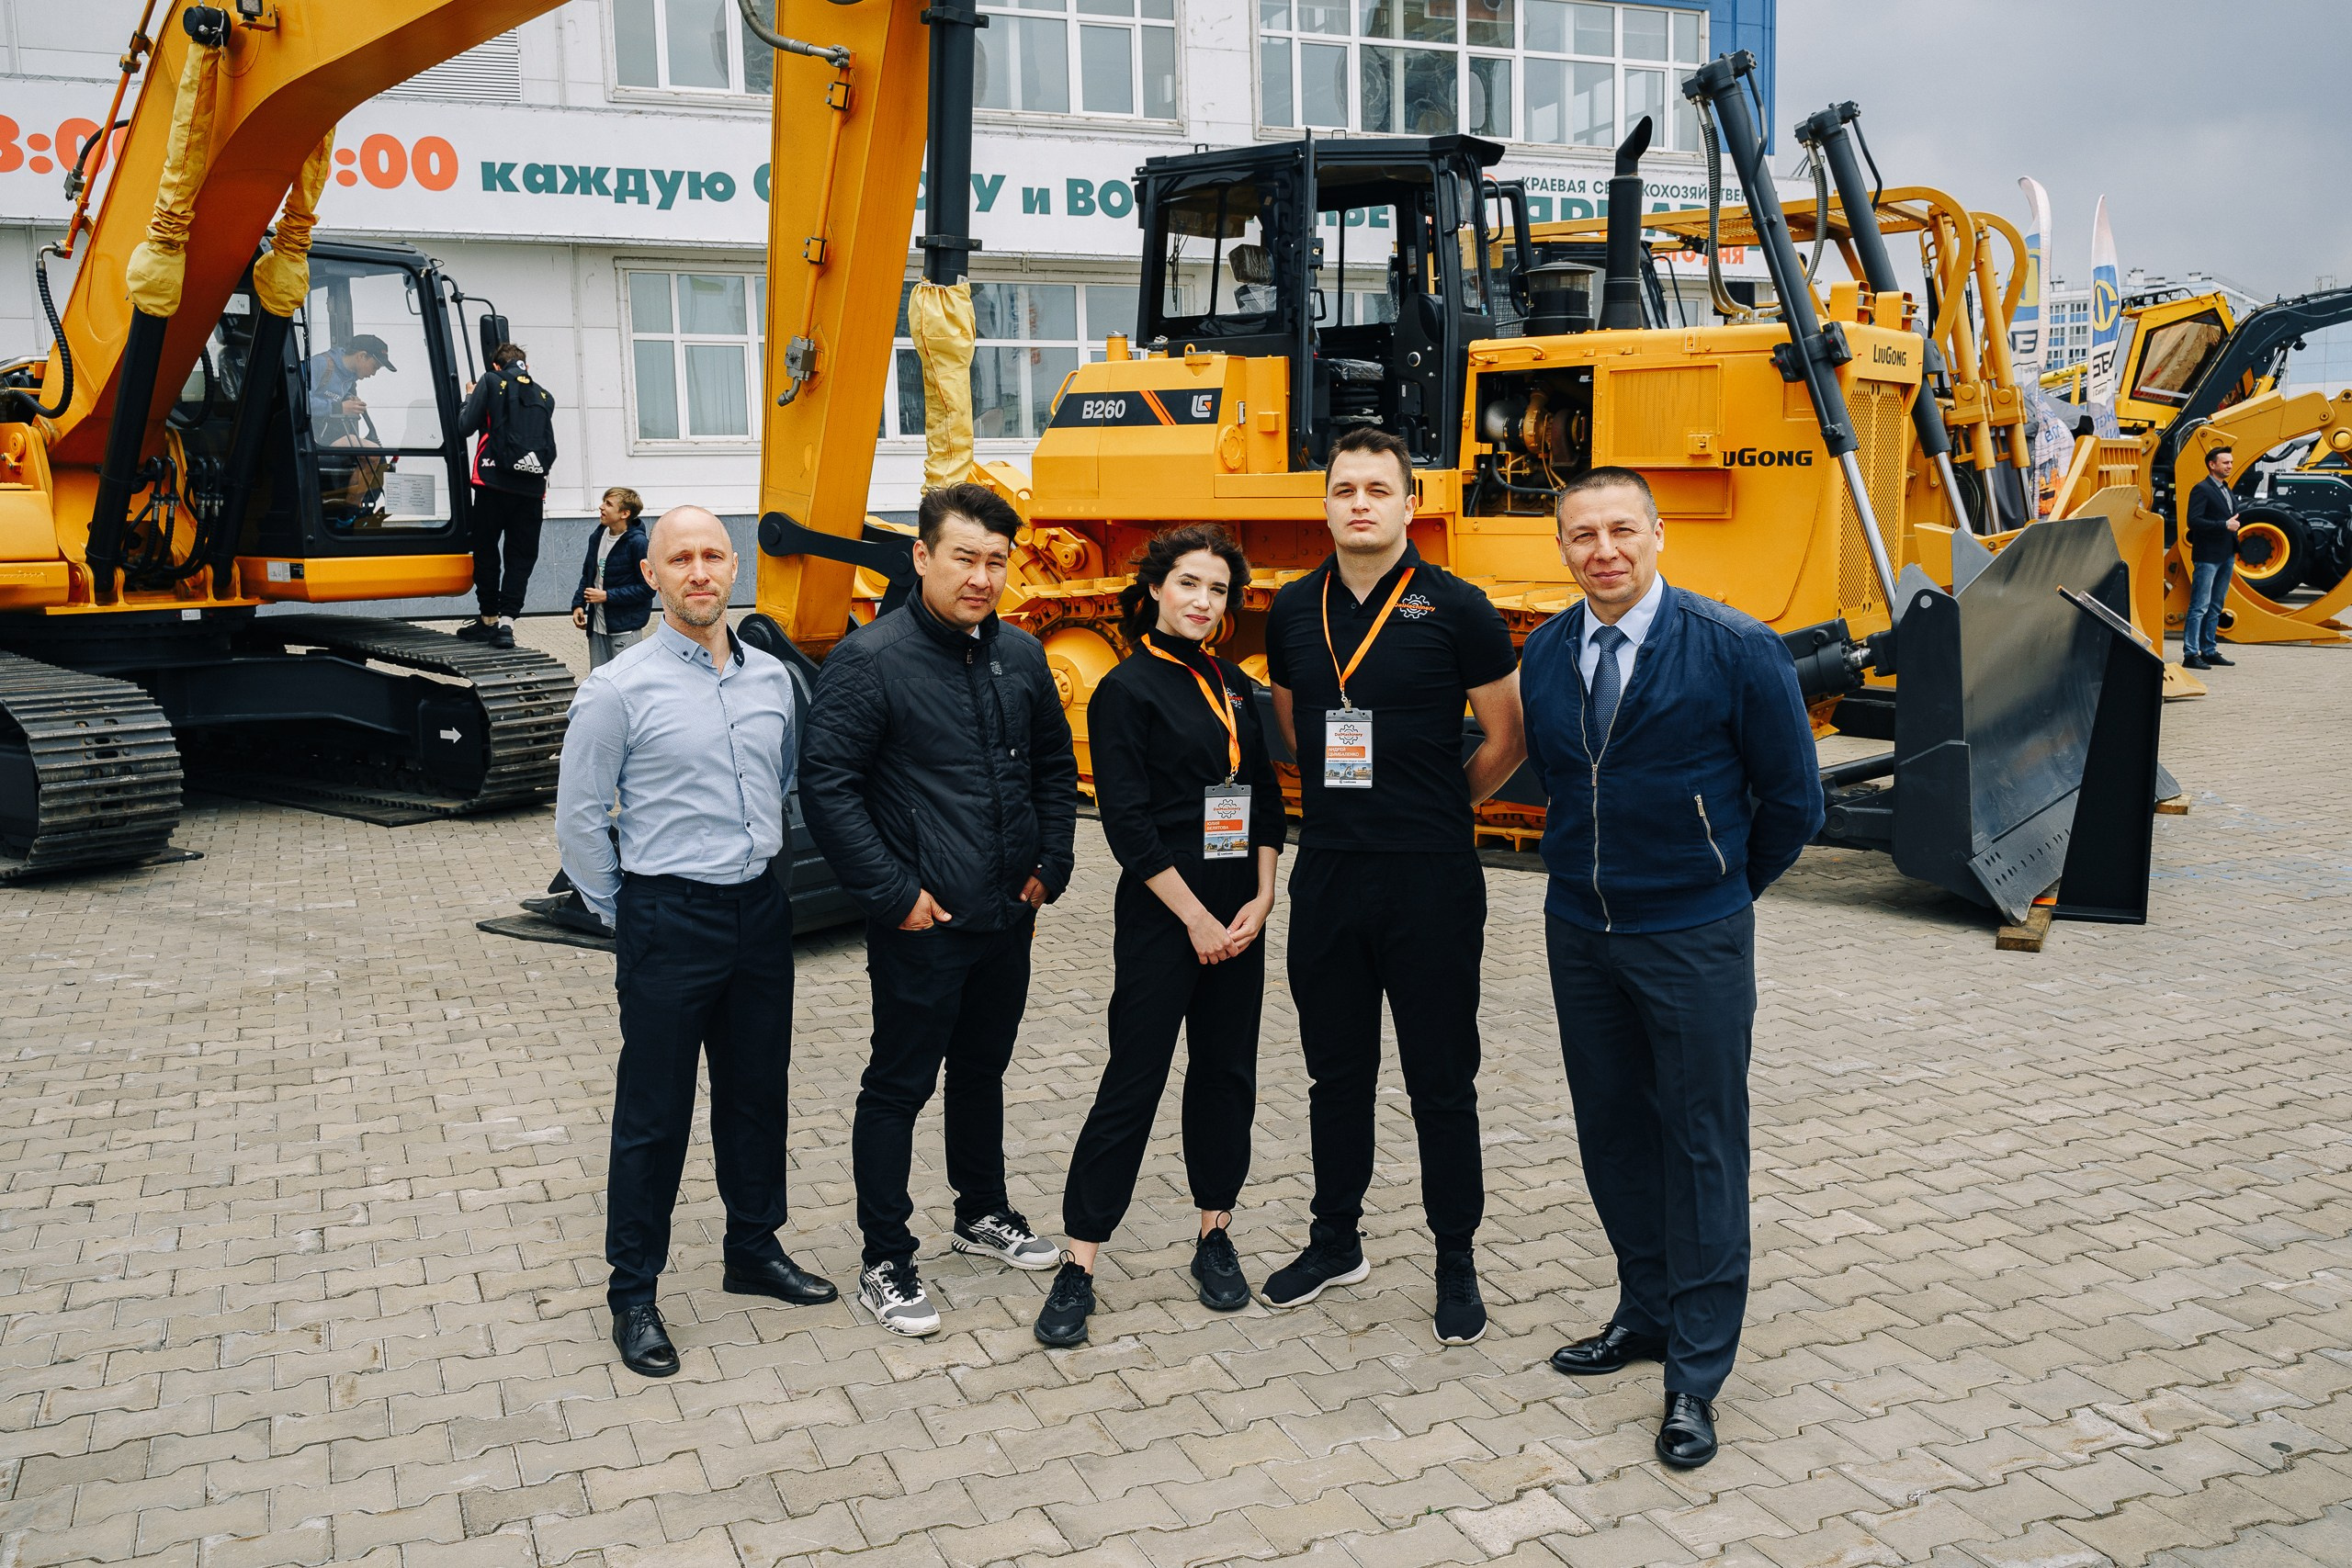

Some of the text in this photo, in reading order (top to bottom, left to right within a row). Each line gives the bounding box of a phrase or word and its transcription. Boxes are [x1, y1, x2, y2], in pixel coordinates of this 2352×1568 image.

[481, 161, 736, 210] каждую
[1022, 187, 1050, 215] и
[1521, 176, 1587, 193] КРАЕВАЯ
[1082, 400, 1126, 420] B260
[514, 463, 544, 474] adidas
